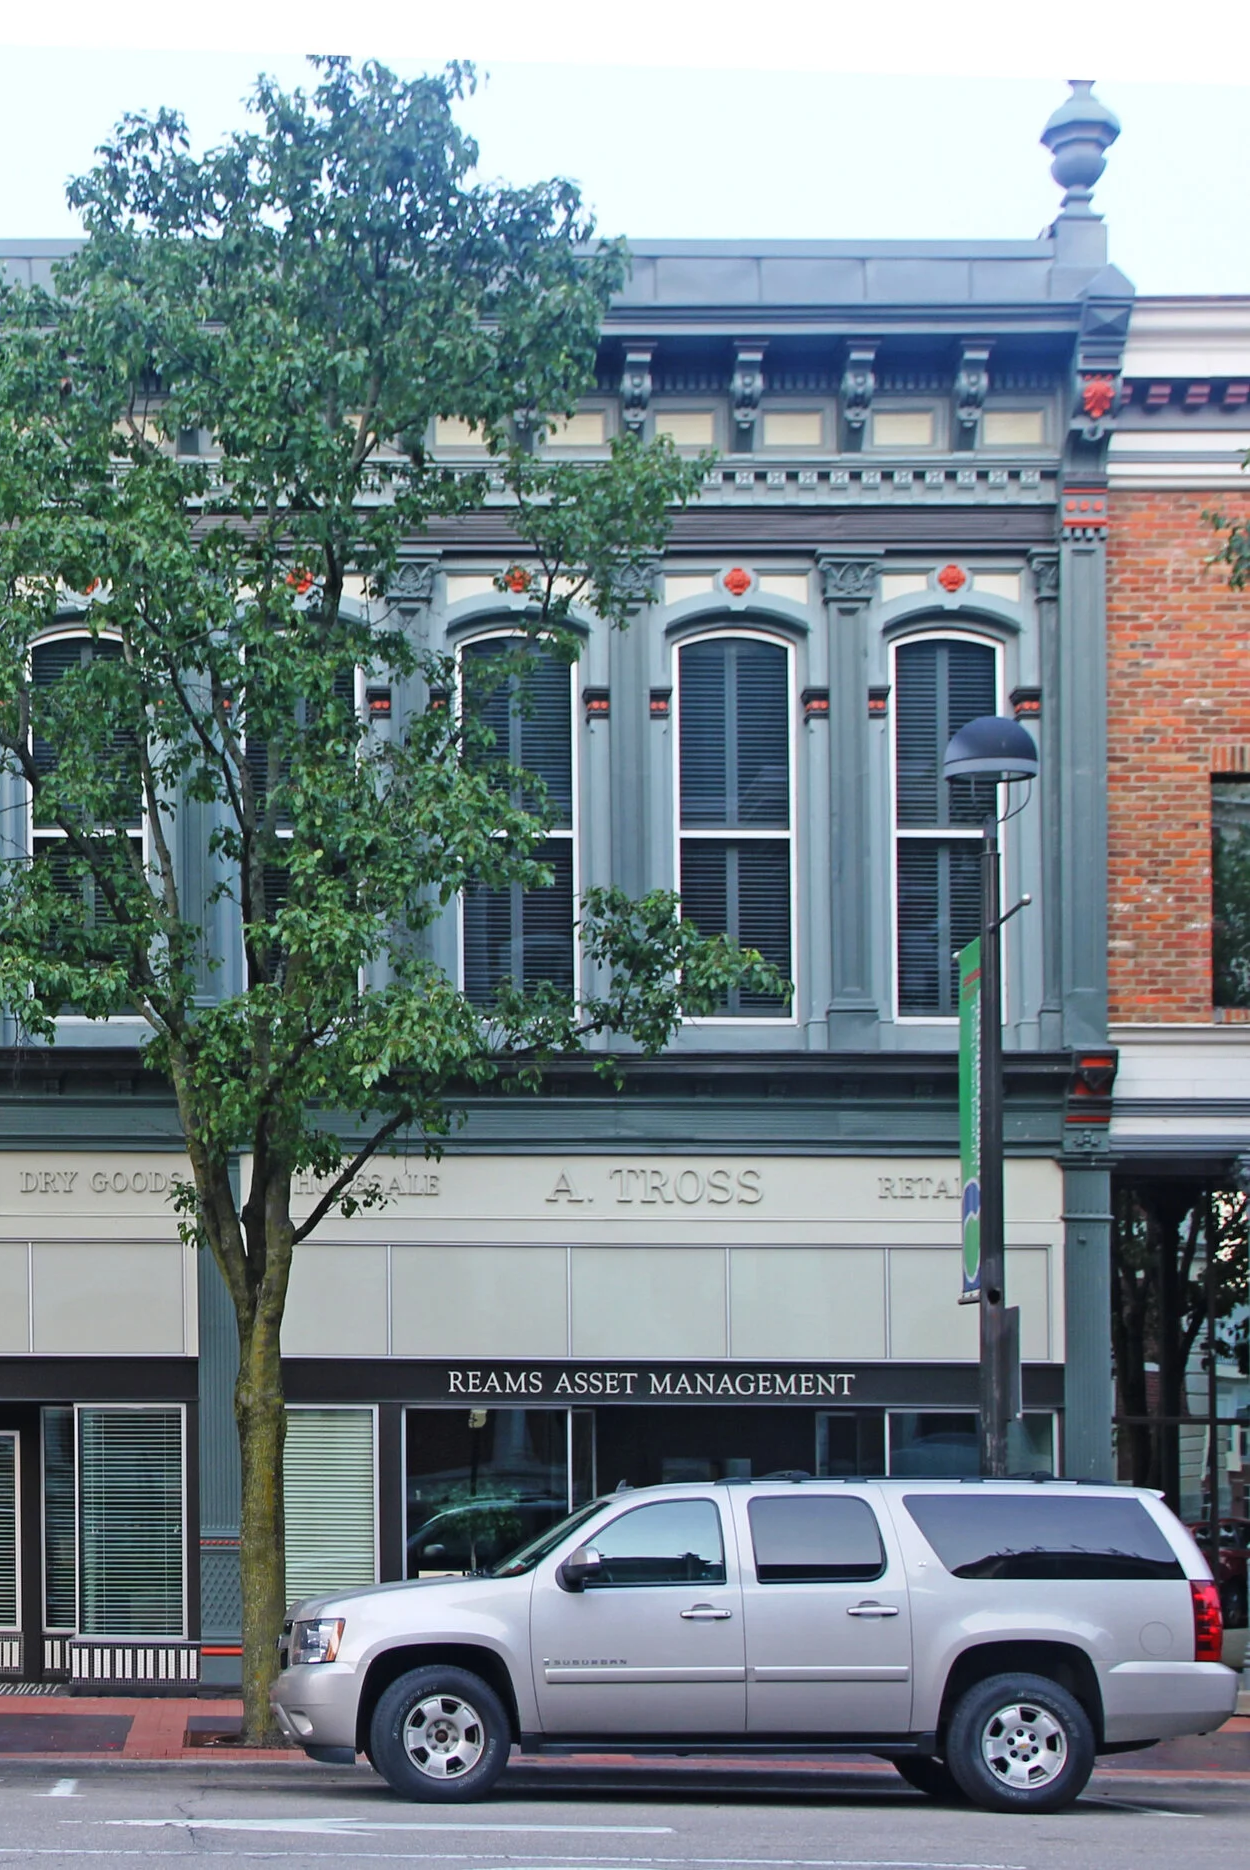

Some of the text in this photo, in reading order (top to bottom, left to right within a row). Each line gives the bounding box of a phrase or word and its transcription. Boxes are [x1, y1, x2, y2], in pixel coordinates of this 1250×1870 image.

[19, 1171, 184, 1194] DRY GOODS
[545, 1167, 764, 1205] A. TROSS
[877, 1176, 962, 1199] RETAI
[448, 1370, 856, 1396] REAMS ASSET MANAGEMENT
